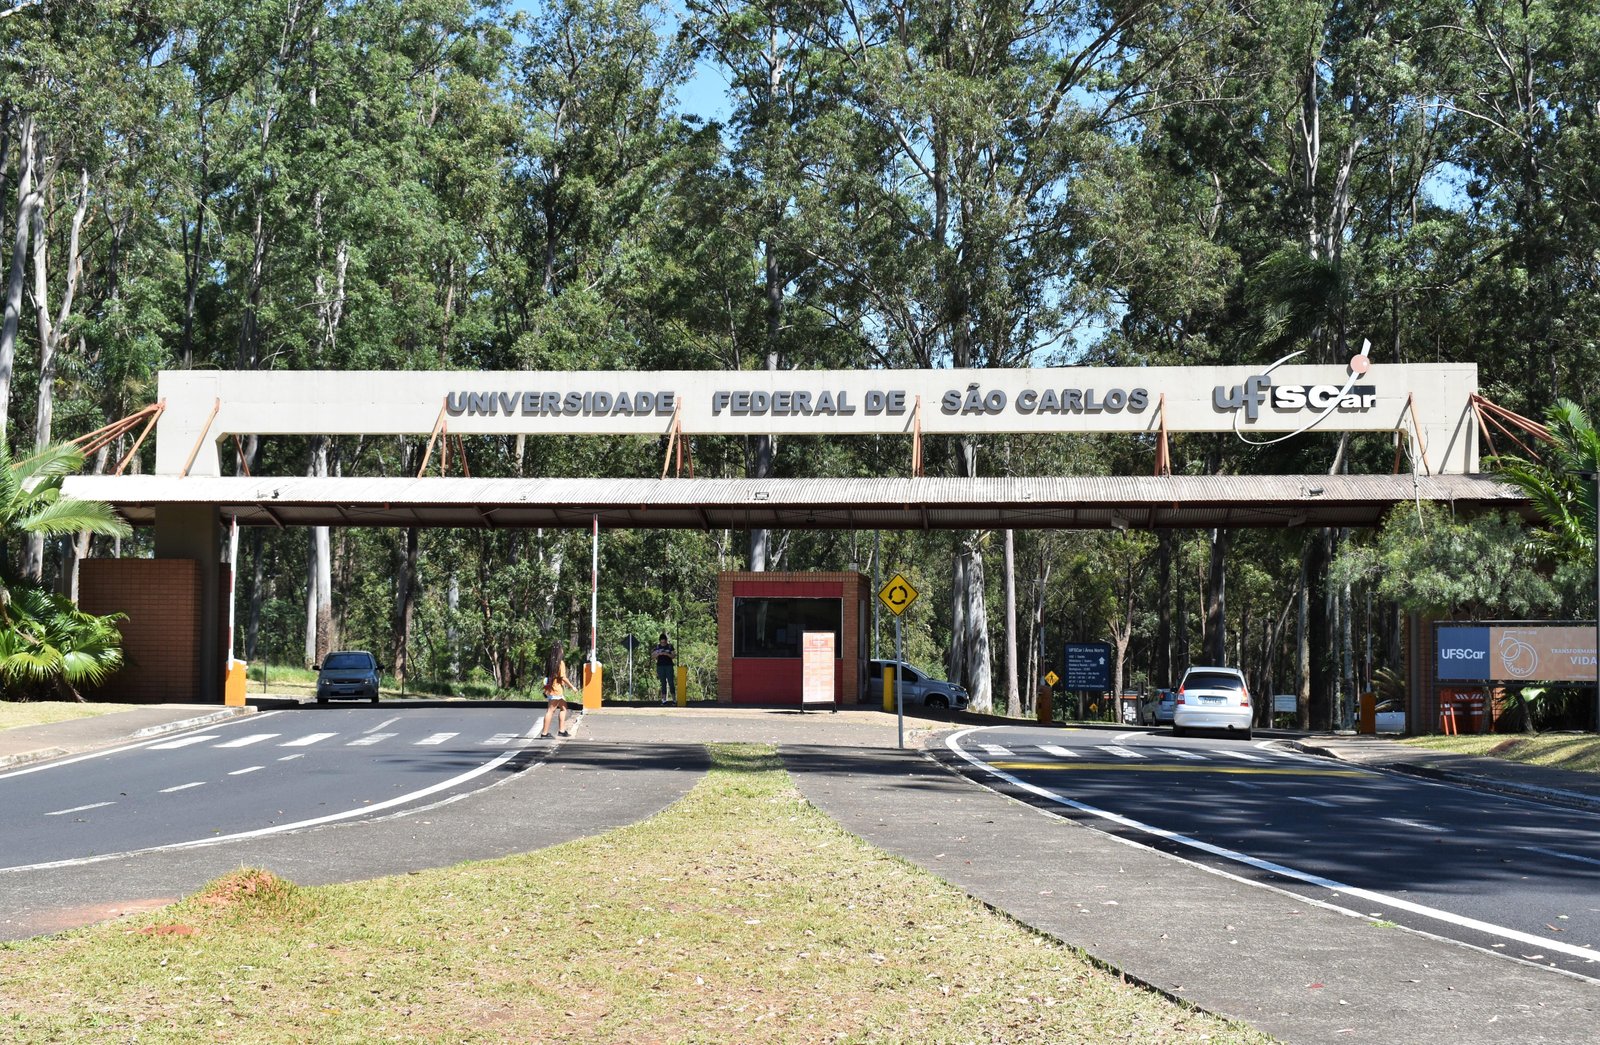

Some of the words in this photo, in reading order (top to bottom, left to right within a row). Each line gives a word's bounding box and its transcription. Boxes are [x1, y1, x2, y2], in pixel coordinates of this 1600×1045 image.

[446, 391, 675, 416] UNIVERSIDADE
[712, 391, 856, 416] FEDERAL
[865, 390, 906, 416] DE
[941, 383, 1007, 415] SÃO
[1015, 388, 1149, 415] CARLOS
[1441, 648, 1486, 660] UFSCar
